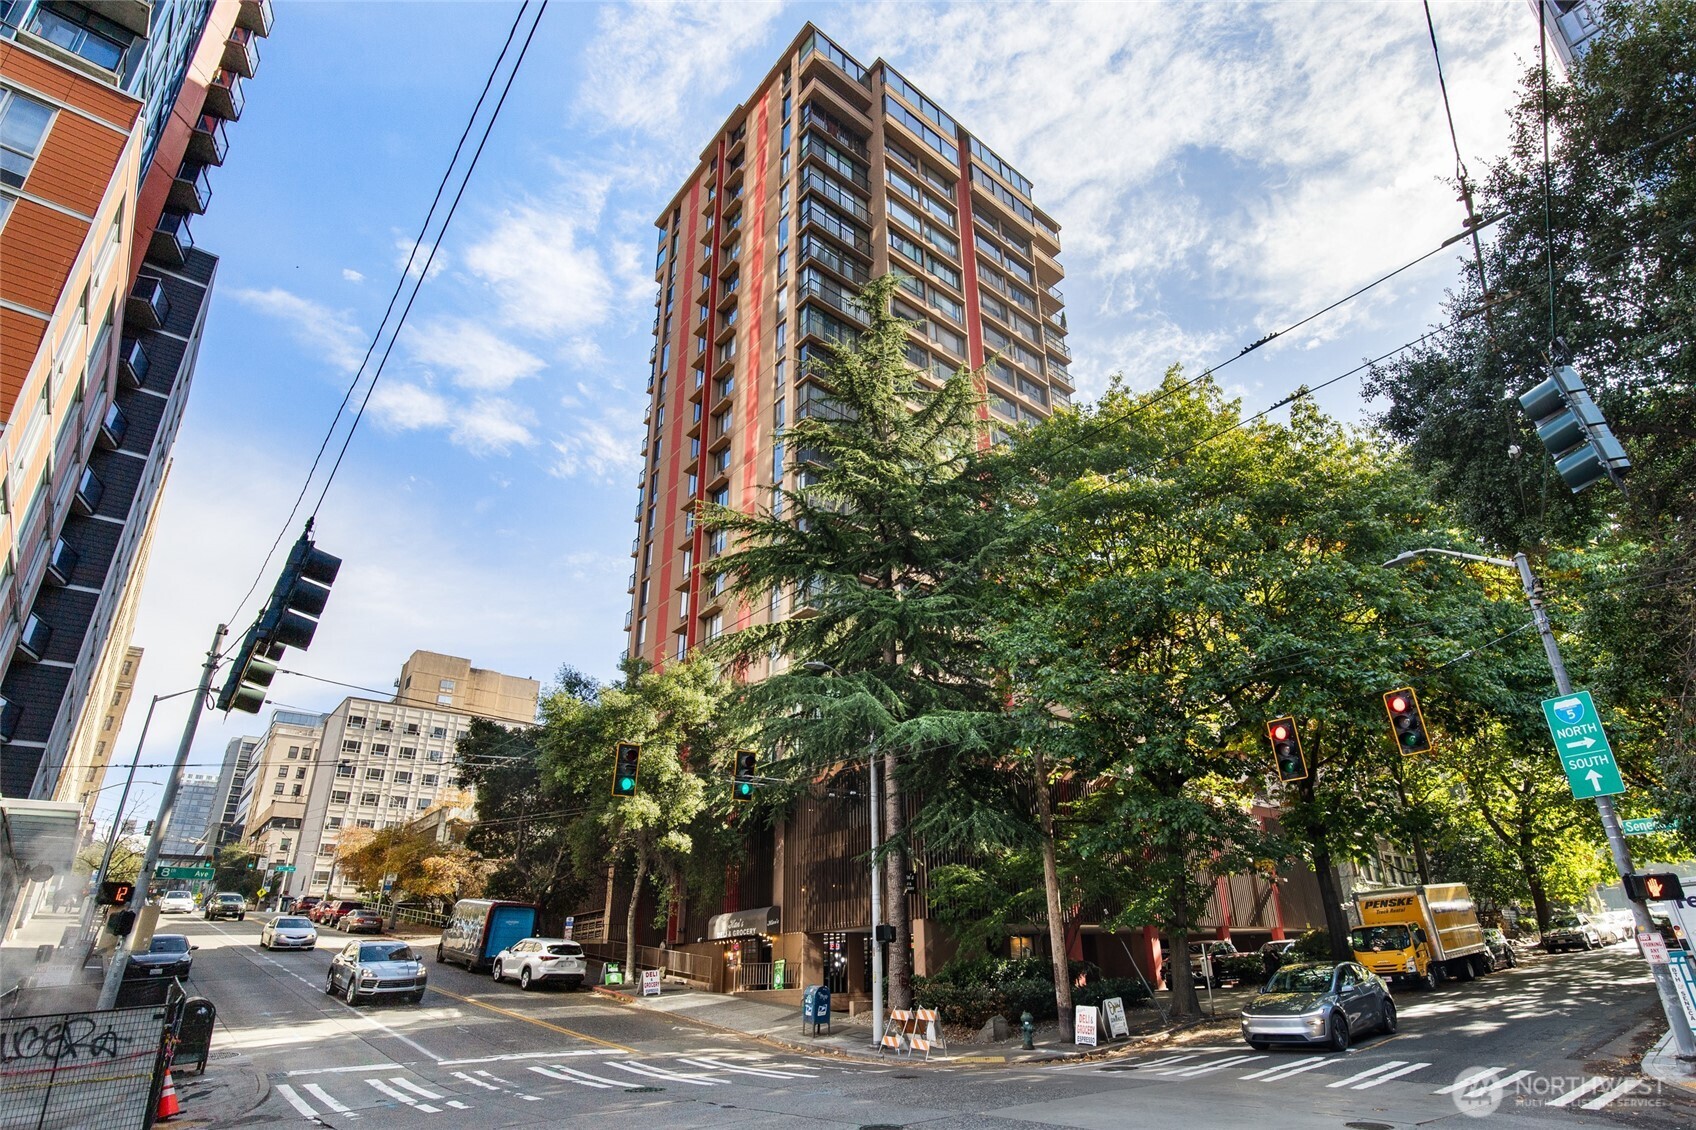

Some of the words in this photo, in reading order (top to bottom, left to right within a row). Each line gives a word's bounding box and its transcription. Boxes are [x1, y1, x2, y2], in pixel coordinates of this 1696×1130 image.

[1566, 709, 1576, 720] 5
[1556, 722, 1598, 739] NORTH
[1568, 754, 1610, 770] SOUTH
[1625, 820, 1667, 832] Sene
[115, 886, 128, 902] 12
[1364, 897, 1414, 910] PENSKE
[732, 927, 757, 937] GROCERY
[1680, 990, 1696, 1021] SENECA
[1079, 1013, 1090, 1024] DELI
[1077, 1024, 1095, 1035] GROCERY
[1077, 1035, 1095, 1044] ESPRESSO
